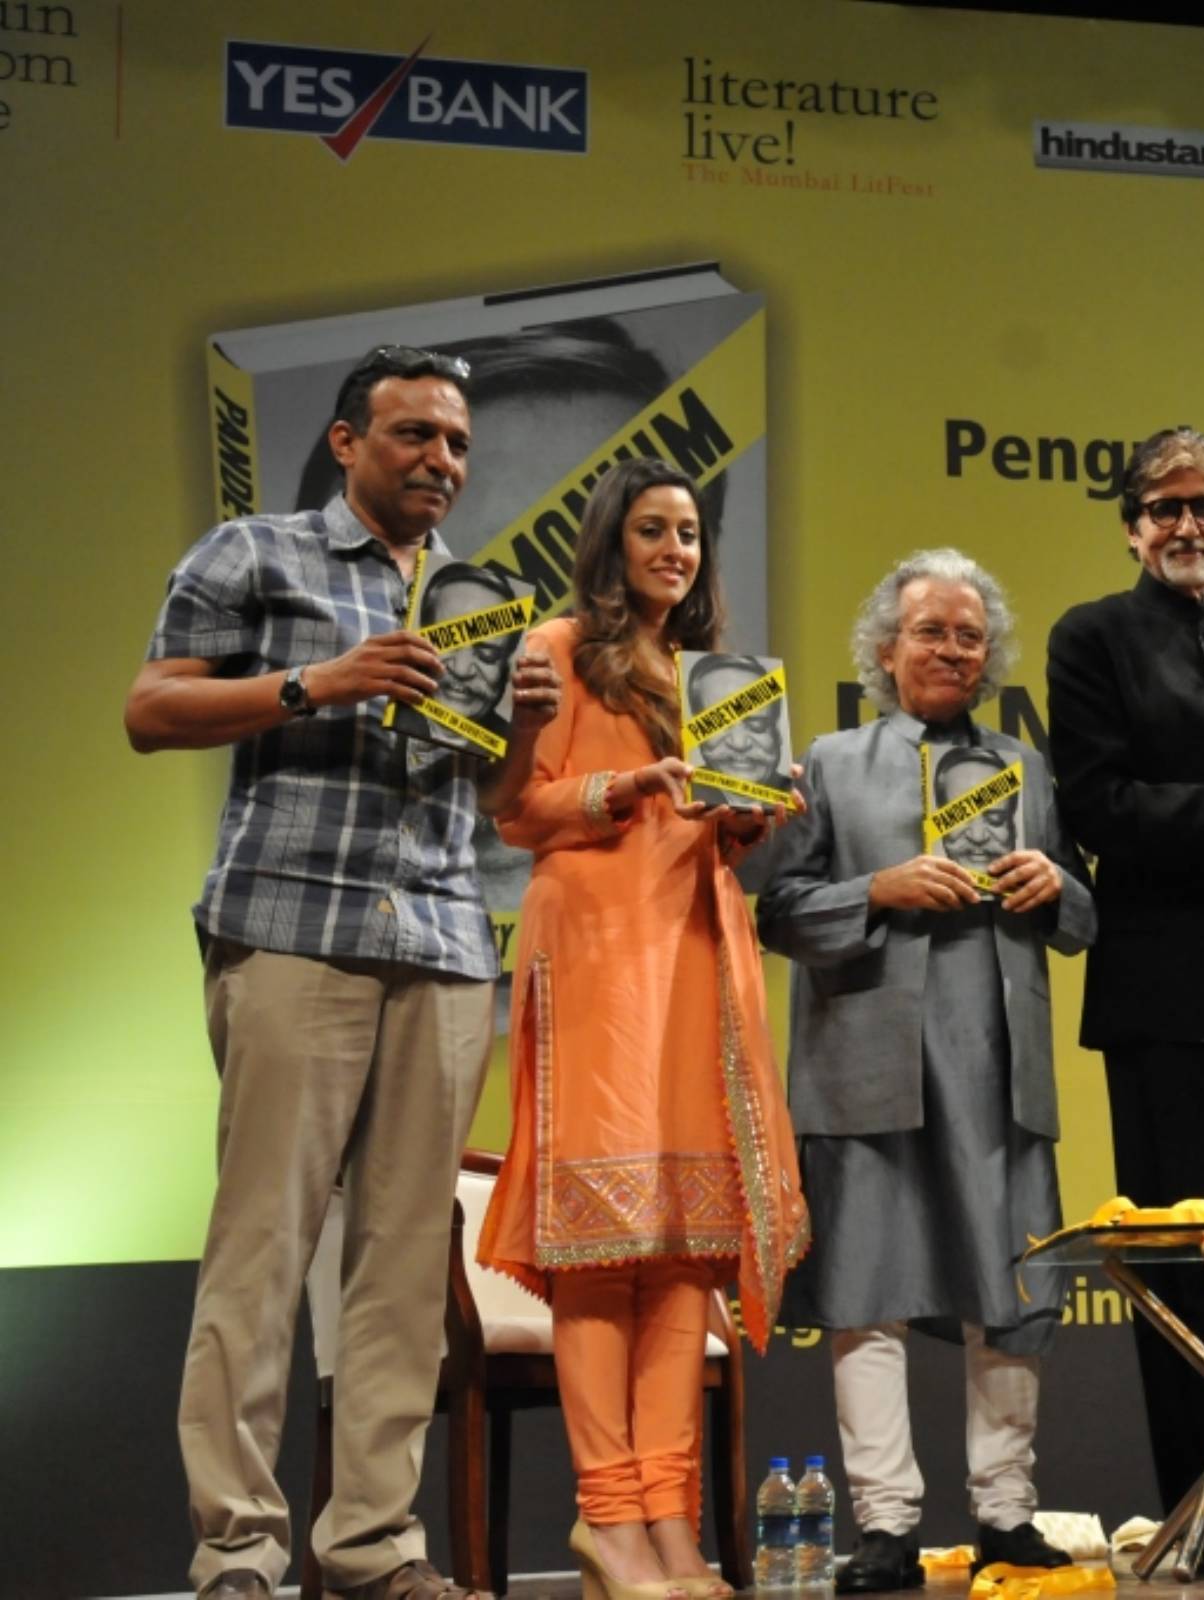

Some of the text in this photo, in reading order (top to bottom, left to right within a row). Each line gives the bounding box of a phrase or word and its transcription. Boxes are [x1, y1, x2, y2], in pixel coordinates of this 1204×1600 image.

[233, 59, 581, 135] YES BANK
[683, 57, 938, 121] literature
[682, 112, 795, 166] live!
[682, 163, 935, 196] The Mumbai LitFest
[421, 604, 527, 649] NDEYMONIUM
[688, 676, 783, 740] PANDEYMONIUM
[932, 770, 1021, 833] PANDEYMONIUM
